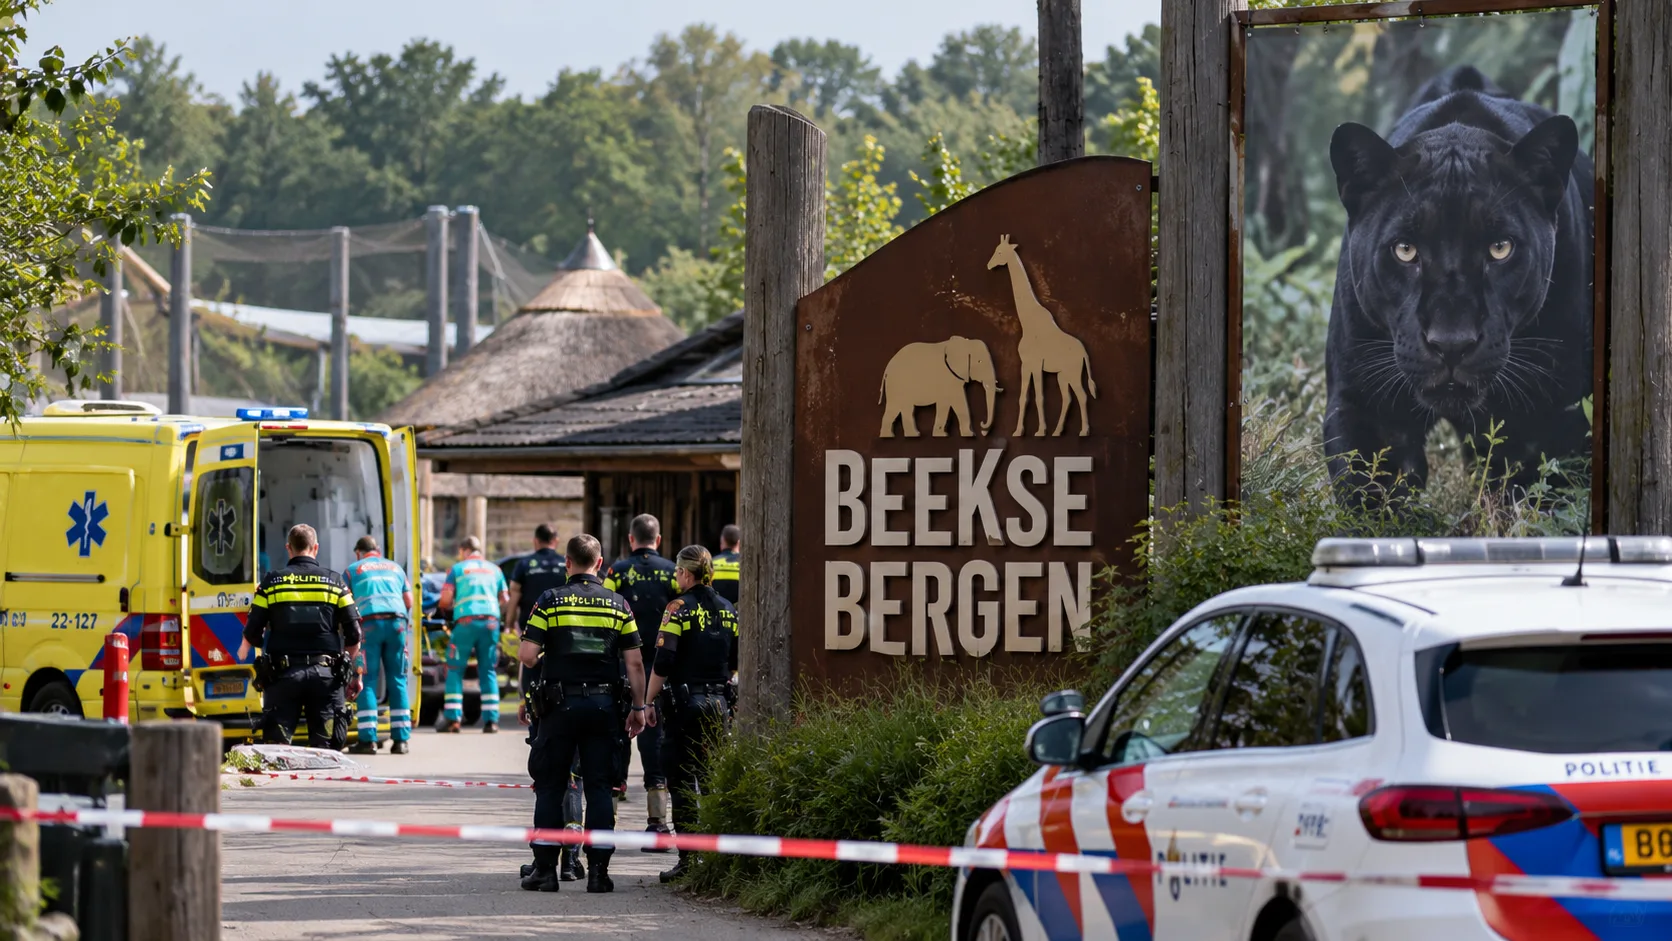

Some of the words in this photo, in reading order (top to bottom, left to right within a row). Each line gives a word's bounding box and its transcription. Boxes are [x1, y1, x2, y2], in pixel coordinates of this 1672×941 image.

[824, 448, 1093, 547] BEEKSE
[51, 612, 98, 629] 22-127
[824, 559, 1093, 657] BERGEN
[1565, 760, 1661, 777] POLITIE
